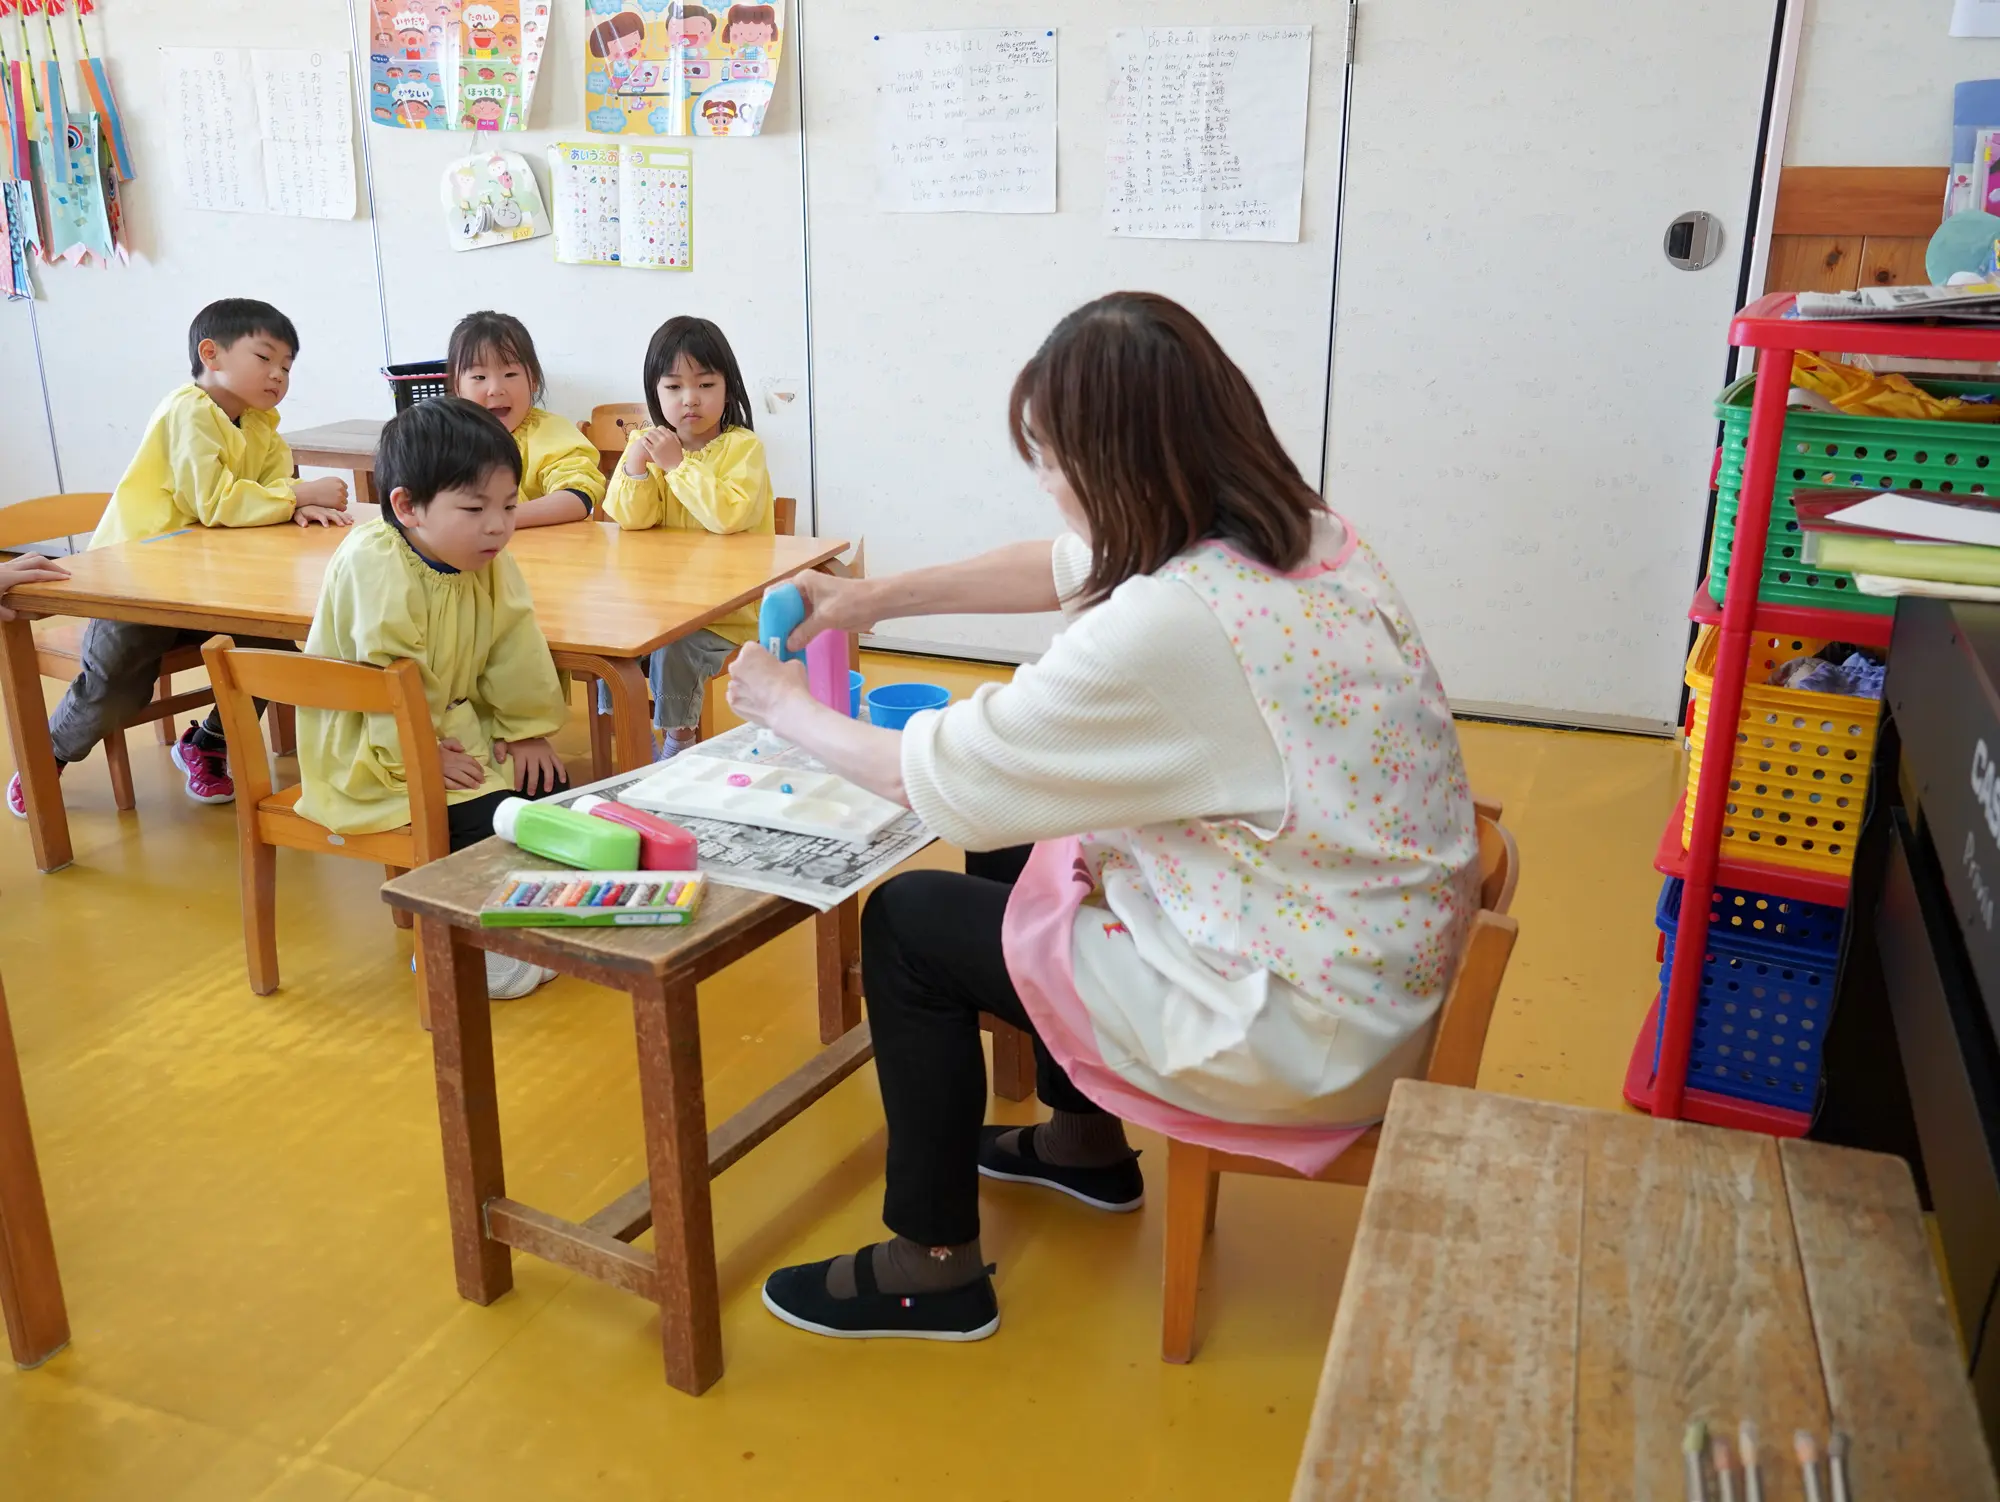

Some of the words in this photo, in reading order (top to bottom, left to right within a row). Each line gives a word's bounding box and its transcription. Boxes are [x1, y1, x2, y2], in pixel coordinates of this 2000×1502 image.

[395, 16, 425, 26] いやだな
[468, 12, 495, 21] たのしい
[468, 88, 502, 96] ほっとする
[463, 223, 470, 235] 4
